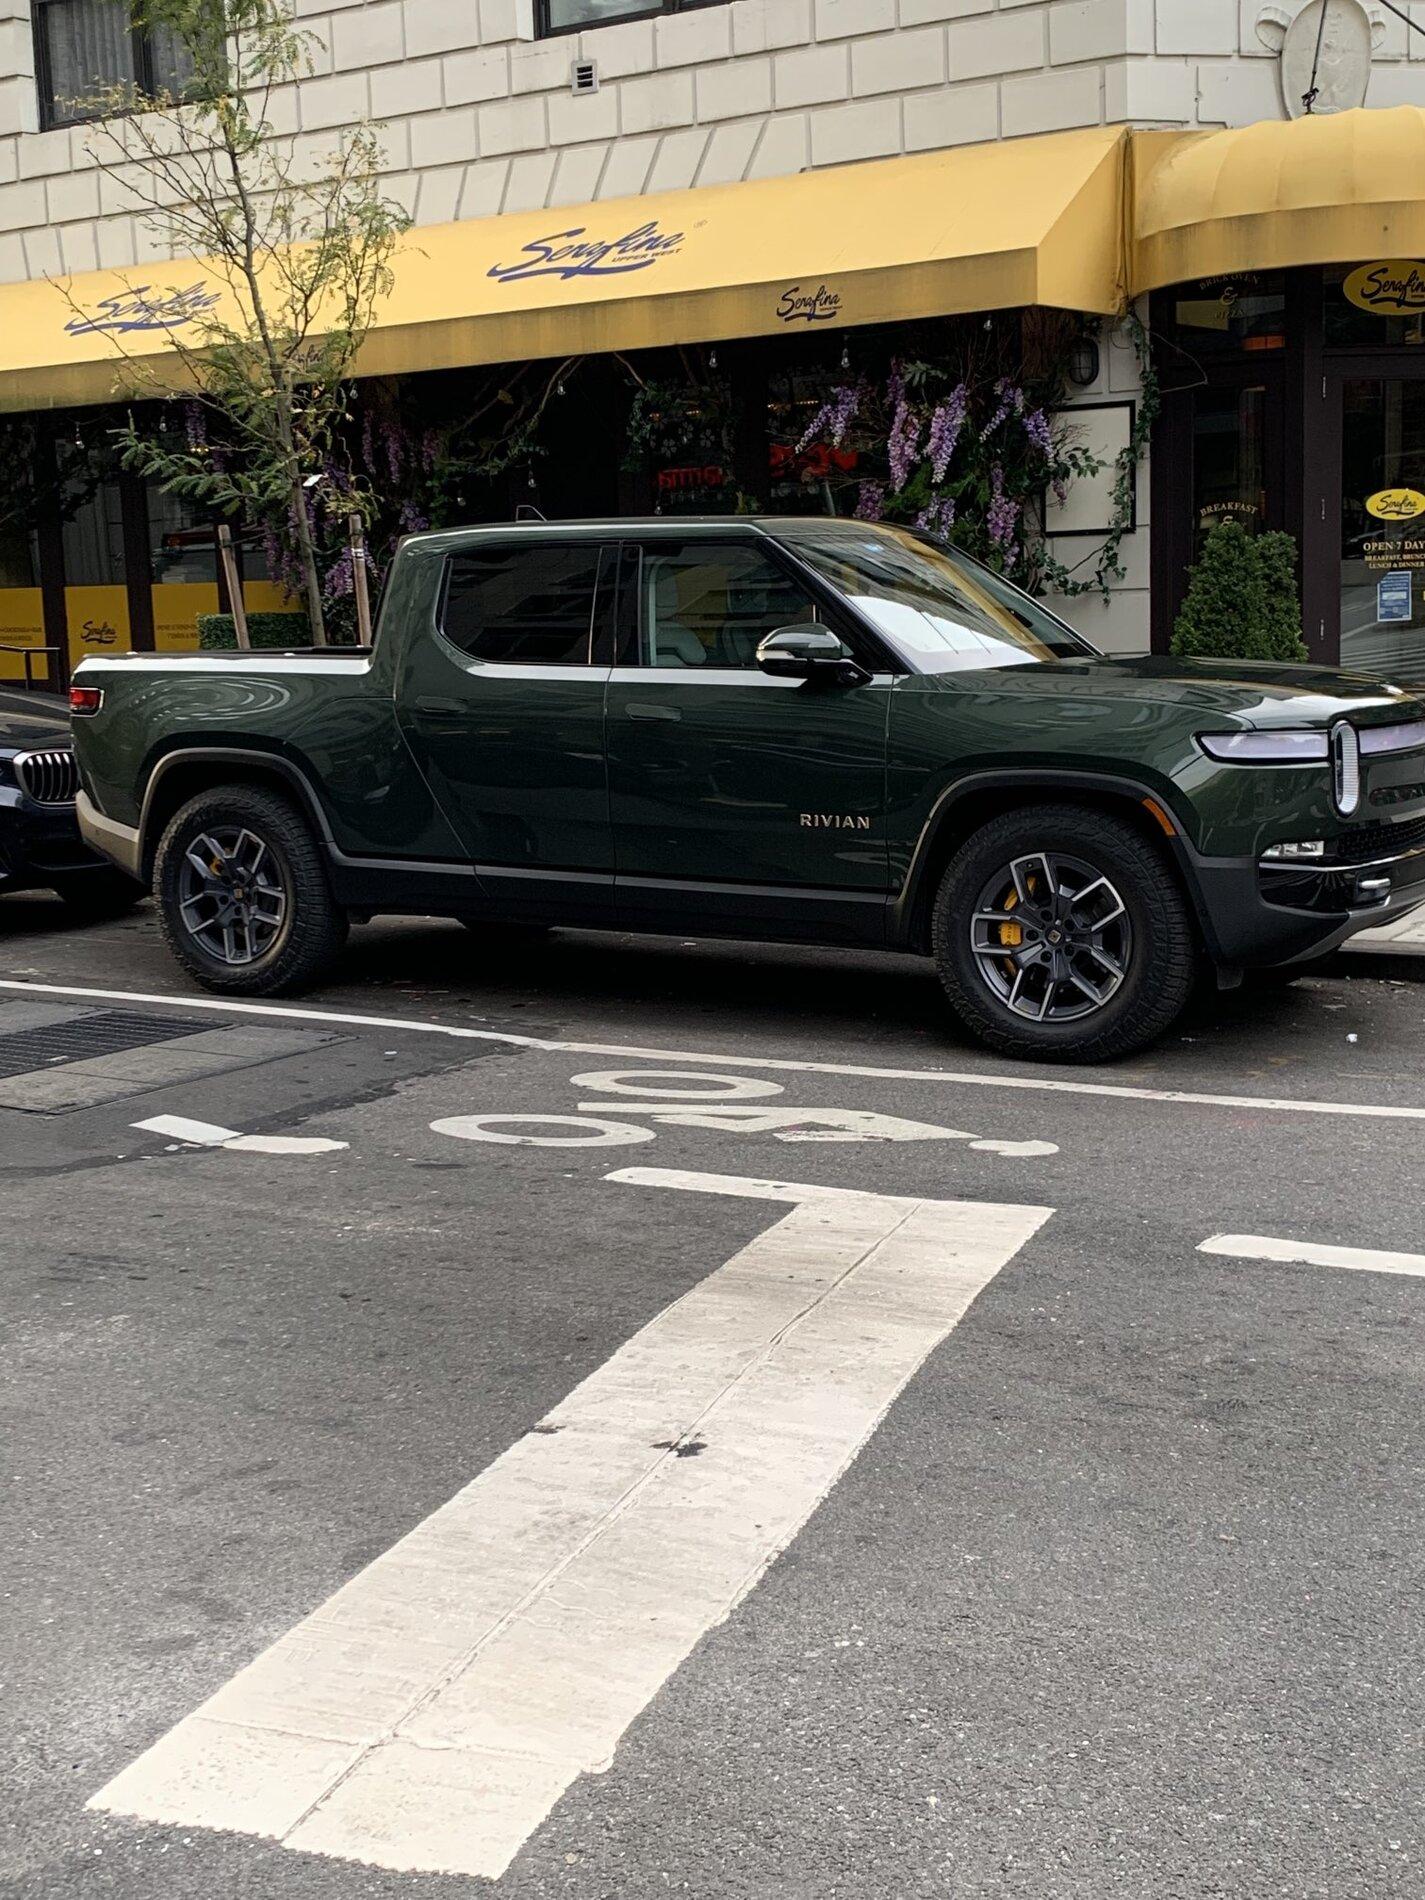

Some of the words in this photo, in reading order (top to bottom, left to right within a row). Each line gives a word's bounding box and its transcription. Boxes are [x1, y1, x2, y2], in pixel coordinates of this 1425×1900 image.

[486, 221, 685, 282] Serafina
[612, 252, 649, 263] UPPER
[651, 248, 683, 258] WEST
[776, 285, 841, 322] Serafina
[1220, 286, 1239, 306] &
[1200, 501, 1259, 517] BREAKFAST
[1362, 541, 1393, 551] OPEN
[1396, 541, 1402, 550] 7
[800, 813, 870, 829] RIVIAN
